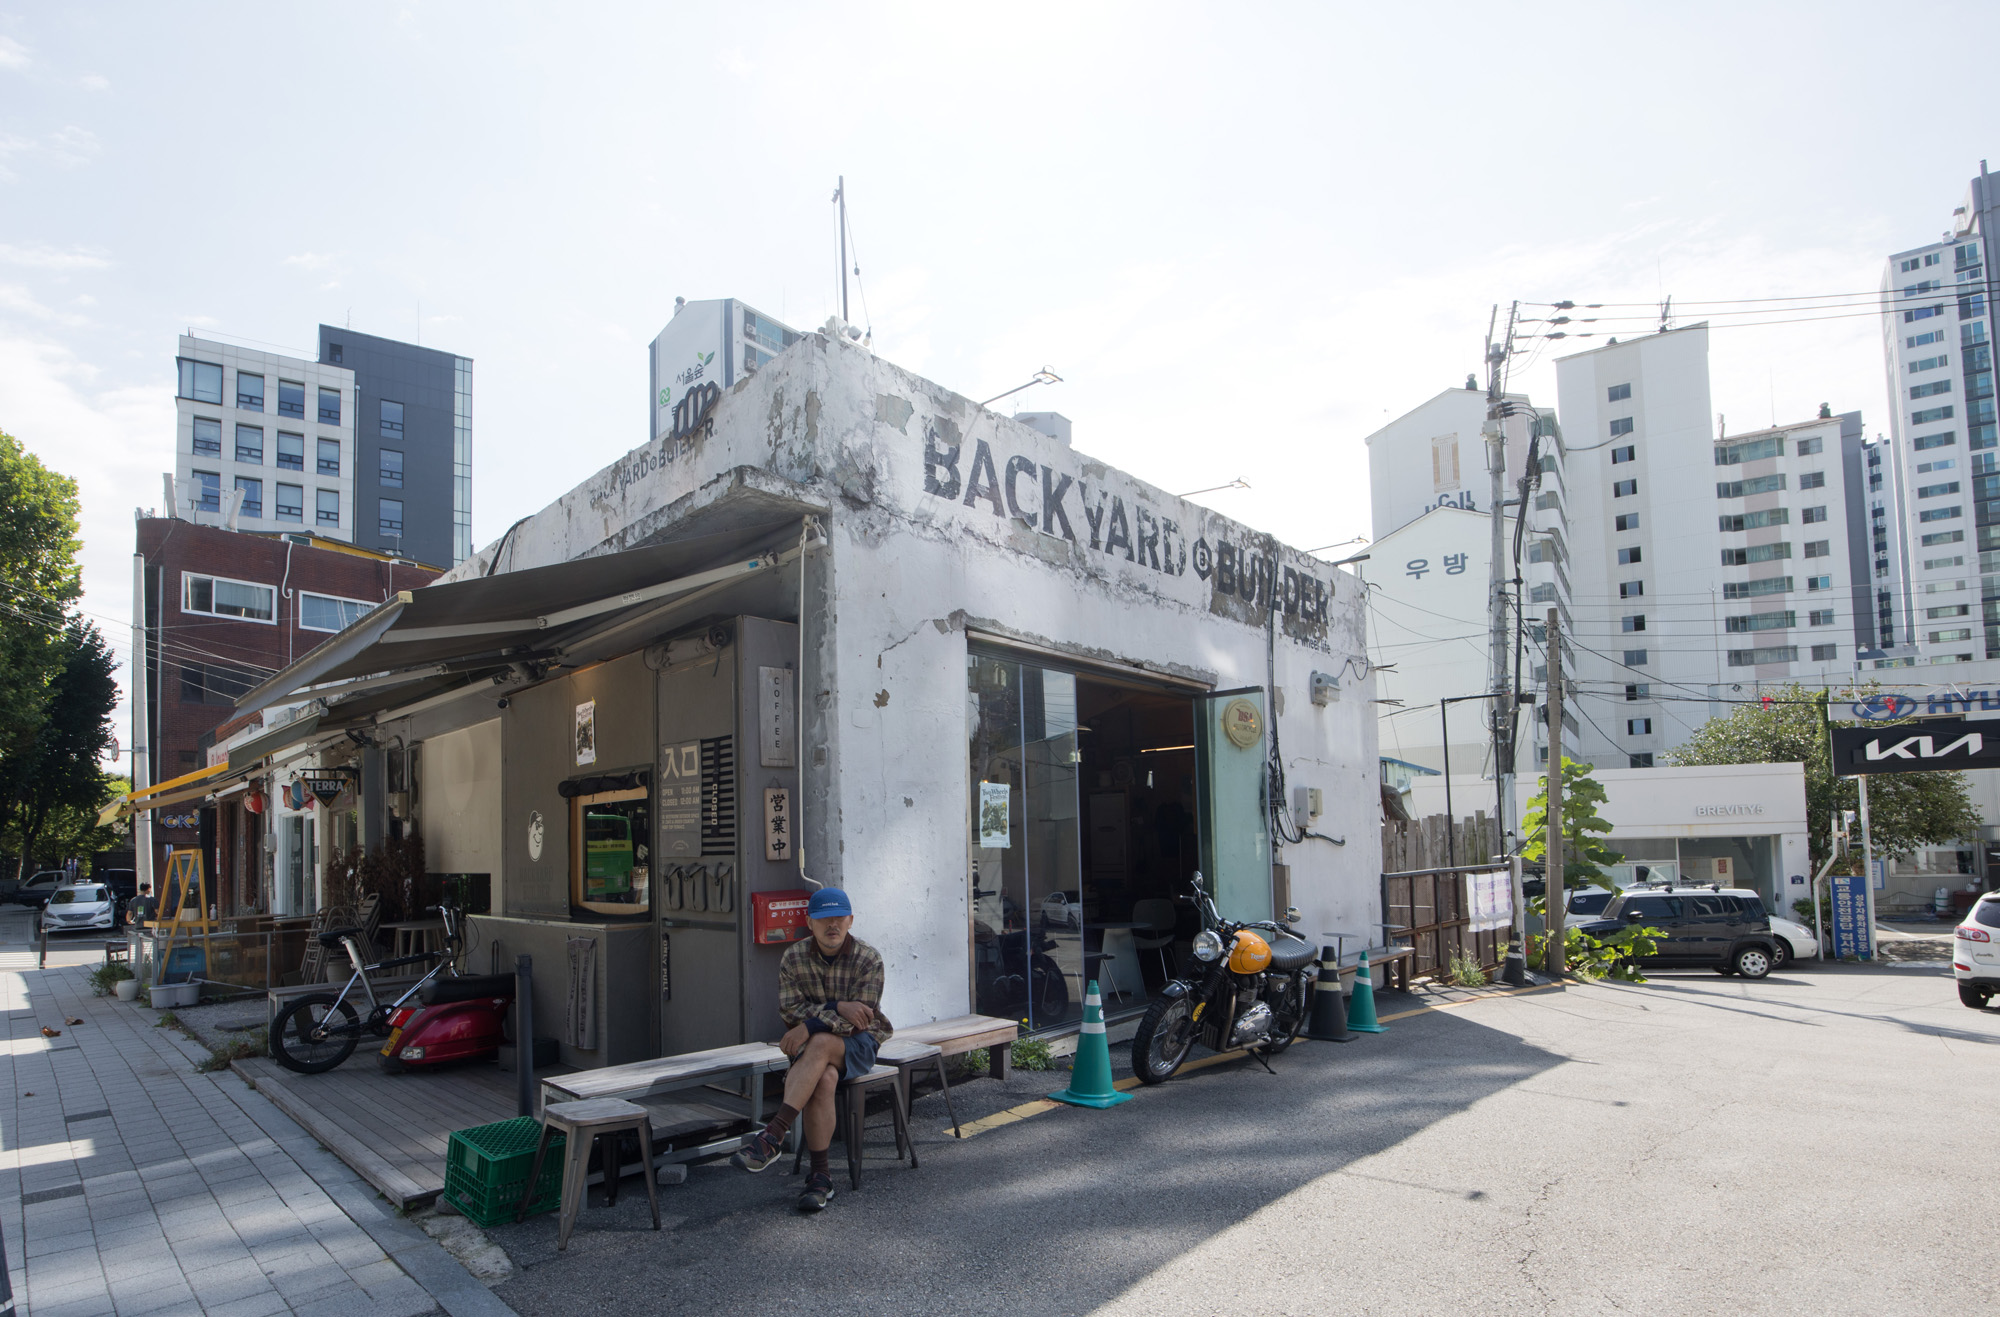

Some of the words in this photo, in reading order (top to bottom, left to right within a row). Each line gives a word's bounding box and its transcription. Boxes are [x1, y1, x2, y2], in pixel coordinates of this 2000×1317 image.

[675, 363, 704, 386] 서울숲
[922, 426, 1188, 577] BACKYARD
[773, 676, 781, 749] COFFEE
[1865, 732, 1983, 761] KIA
[662, 745, 699, 780] 入口
[306, 780, 344, 792] TERRA
[770, 793, 787, 856] 営業中
[1695, 804, 1765, 817] BREVITY5
[781, 908, 808, 918] POST
